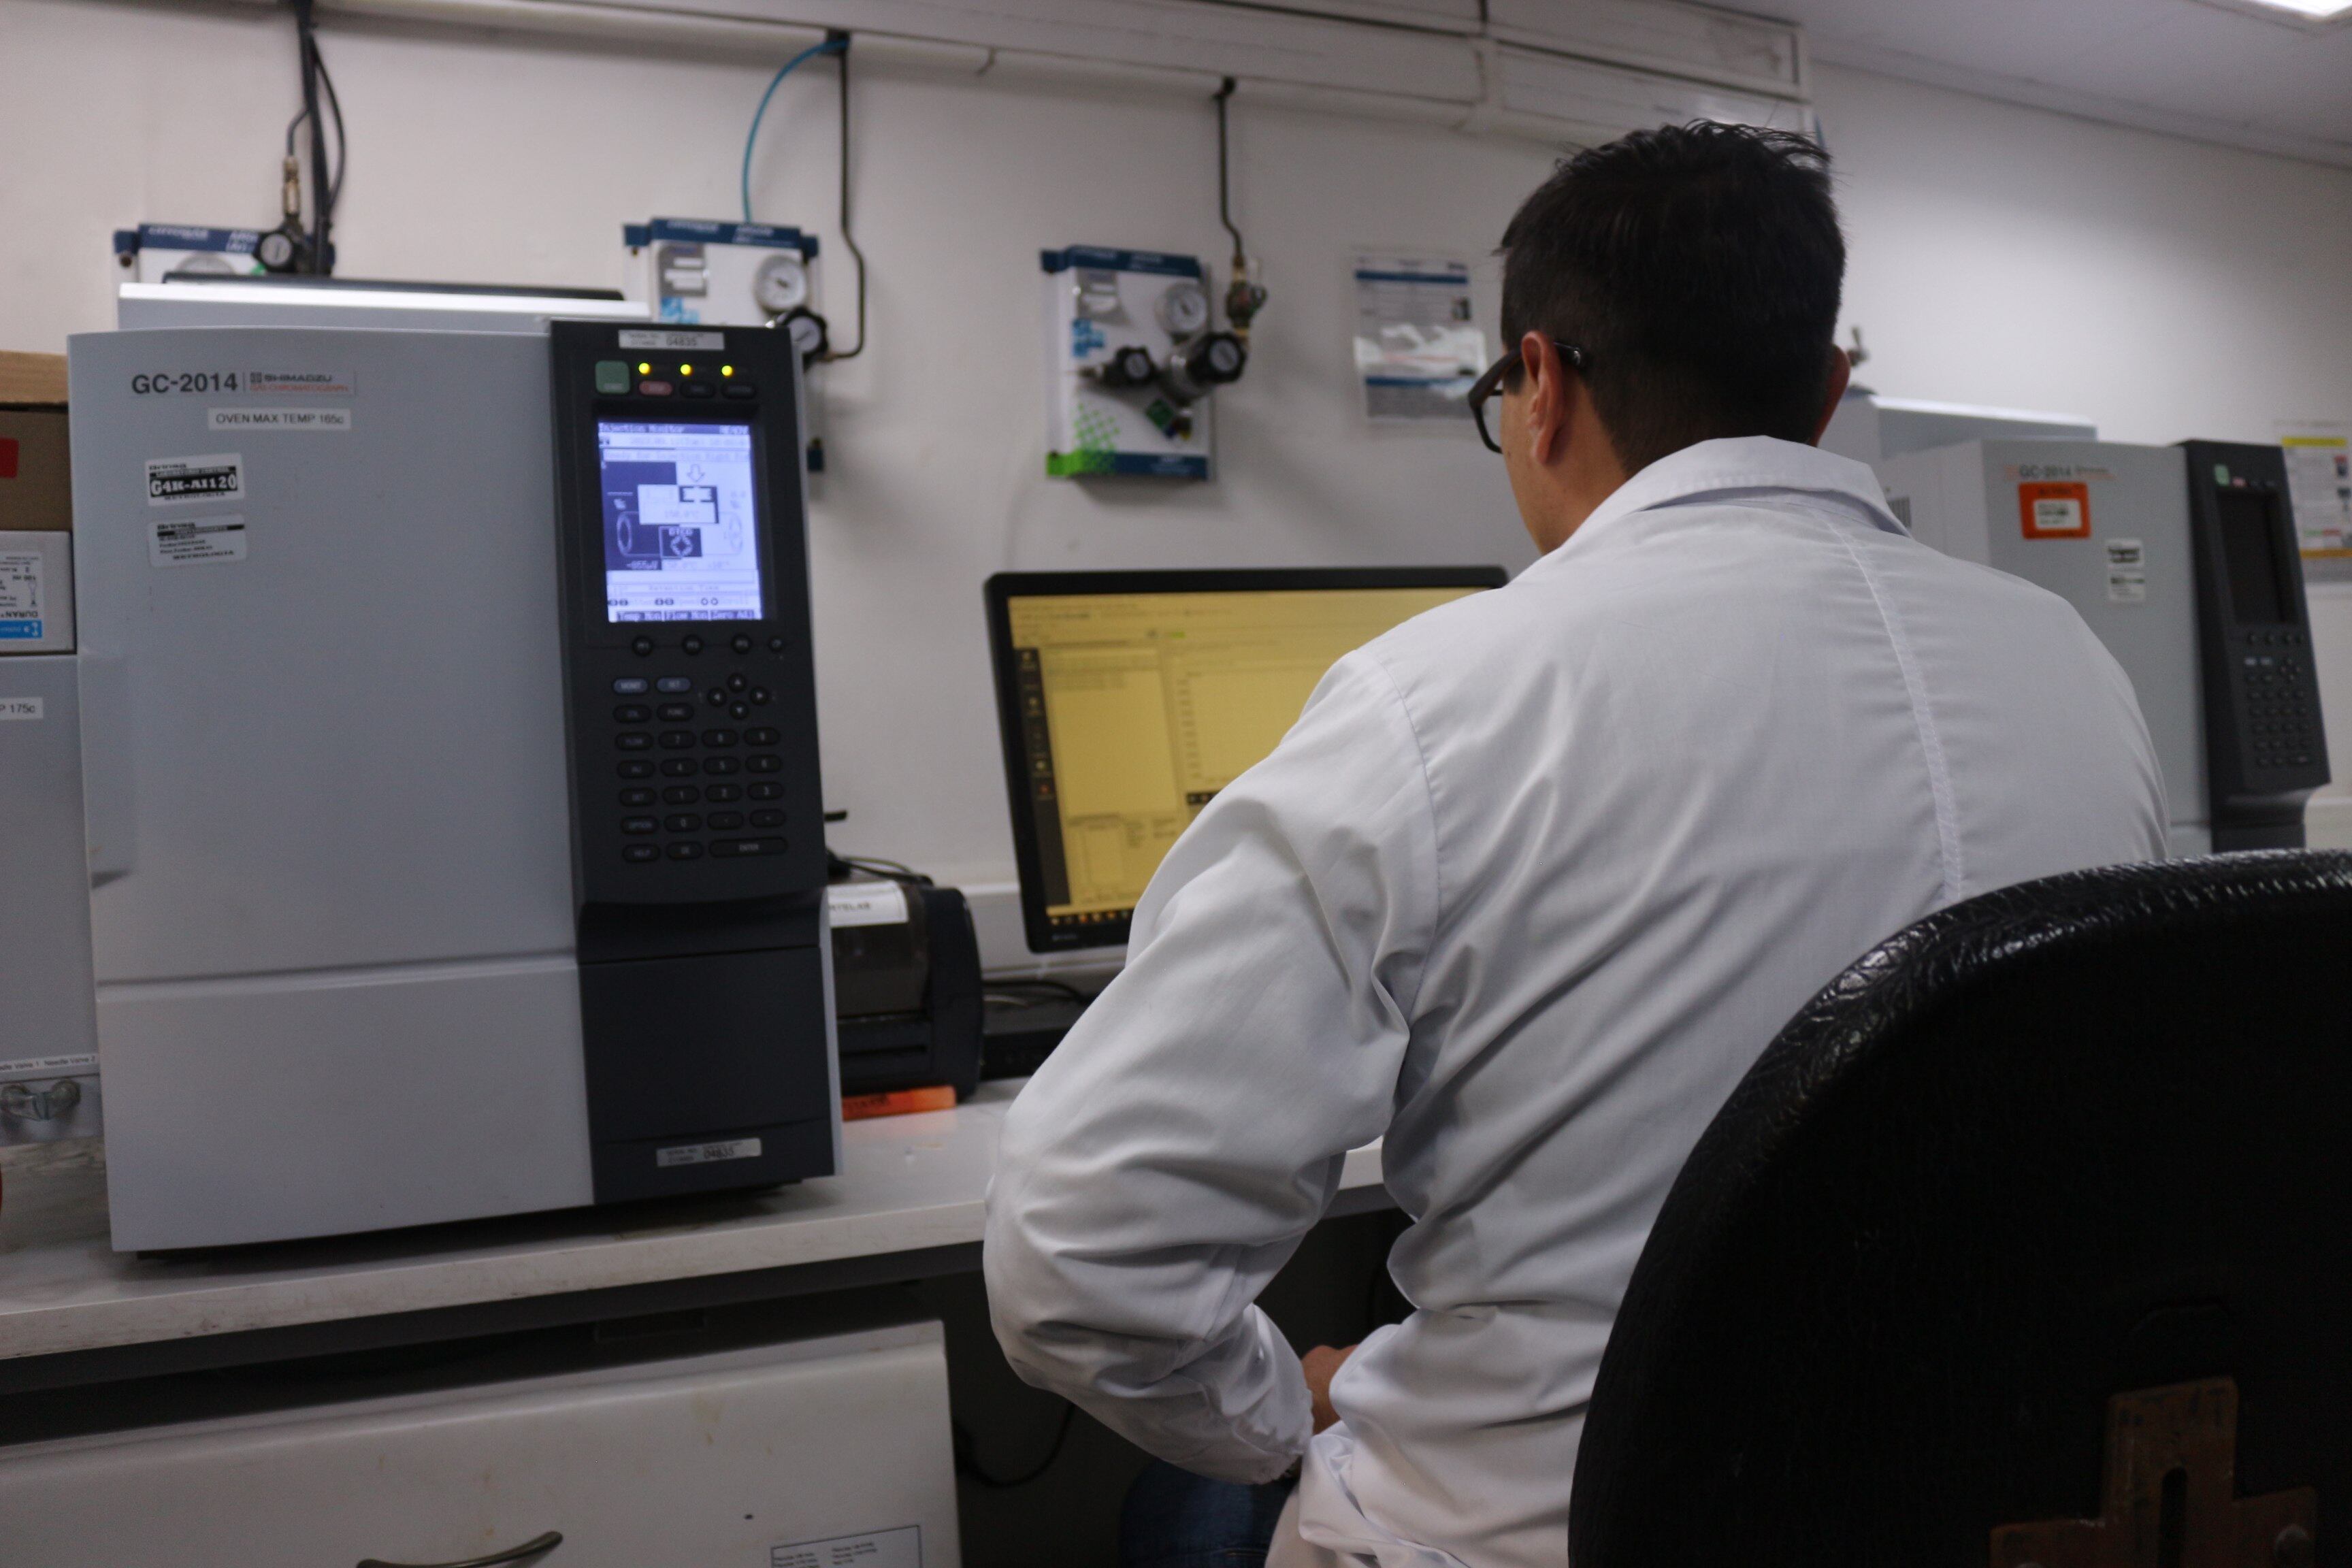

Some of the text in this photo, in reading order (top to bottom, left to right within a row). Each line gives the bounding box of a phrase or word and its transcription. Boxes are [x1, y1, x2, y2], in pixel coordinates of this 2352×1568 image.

[132, 372, 333, 394] GC-2014 SHIMADZU
[216, 413, 252, 424] OVEN
[253, 413, 278, 424] MAX
[283, 413, 315, 425] TEMP
